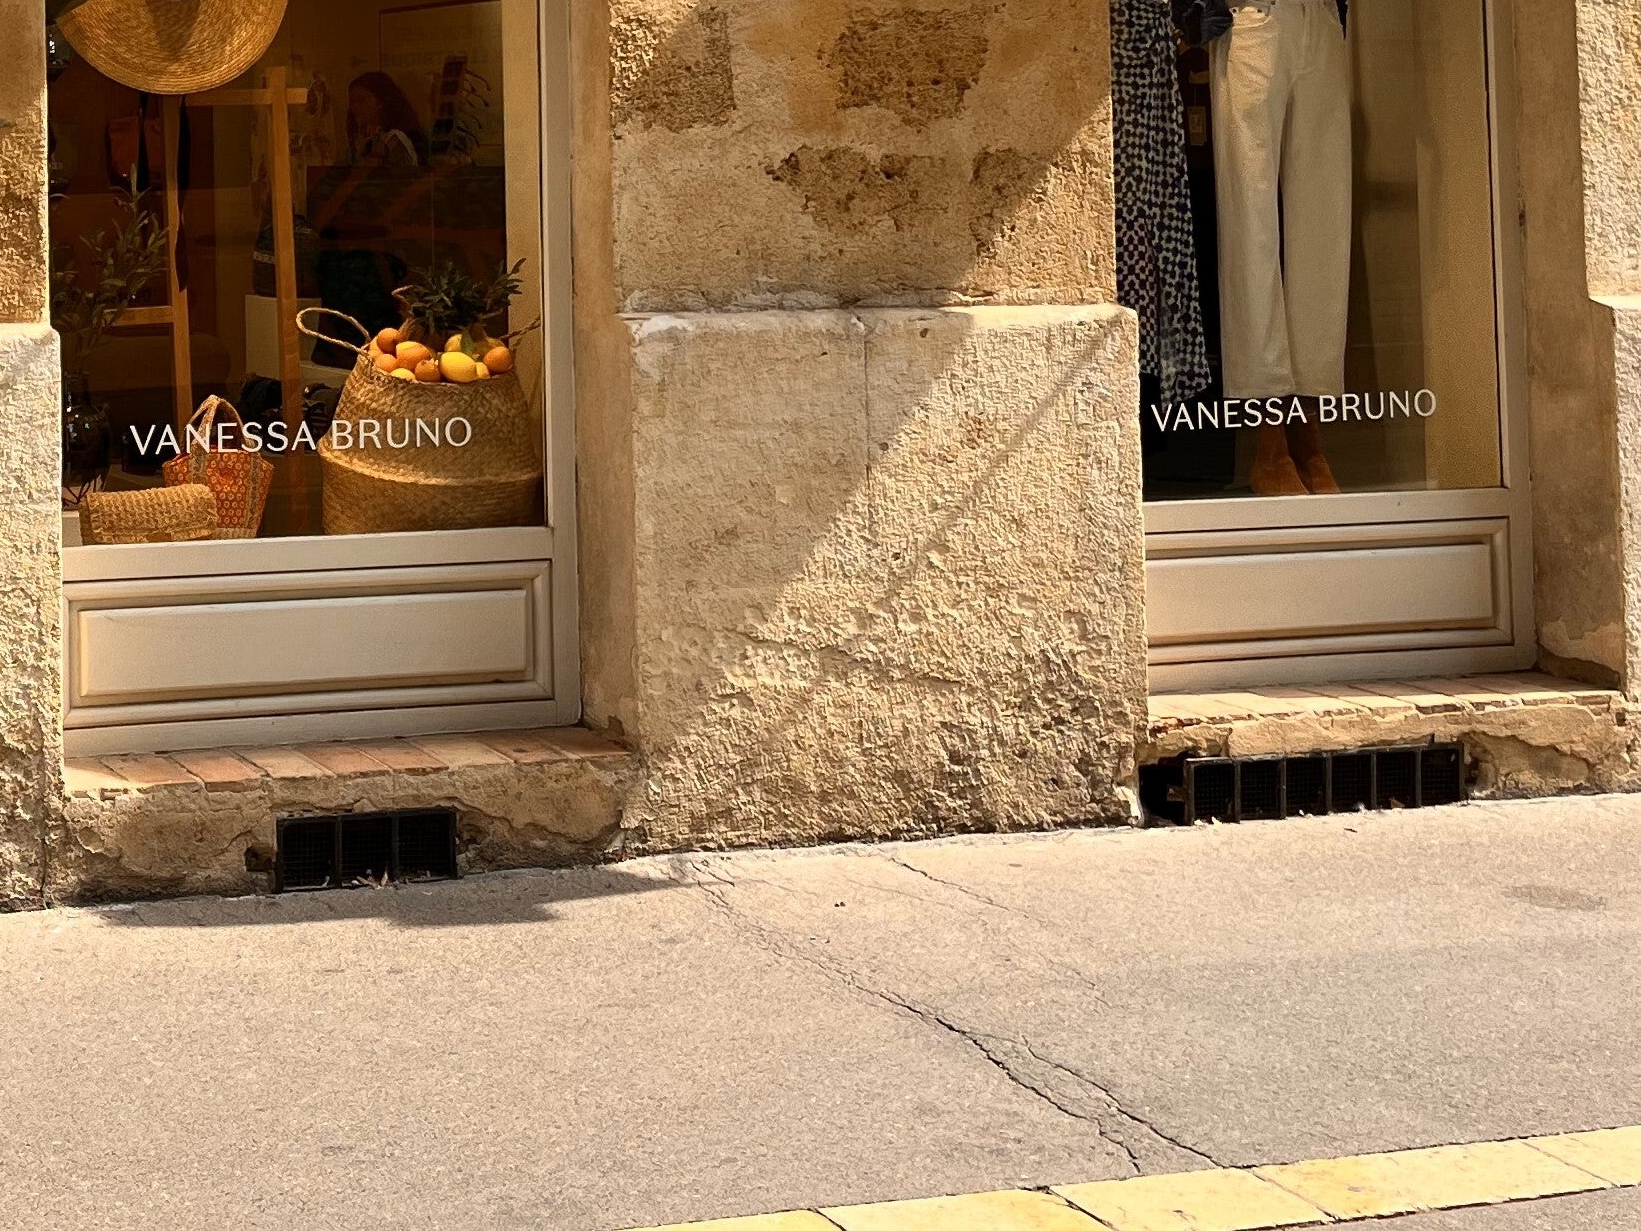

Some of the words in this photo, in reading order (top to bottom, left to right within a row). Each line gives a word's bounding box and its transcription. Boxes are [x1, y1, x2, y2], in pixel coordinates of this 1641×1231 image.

[1151, 396, 1308, 432] VANESSA
[1319, 388, 1437, 422] BRUNO
[129, 421, 318, 456] VANESSA
[331, 417, 473, 450] BRUNO
